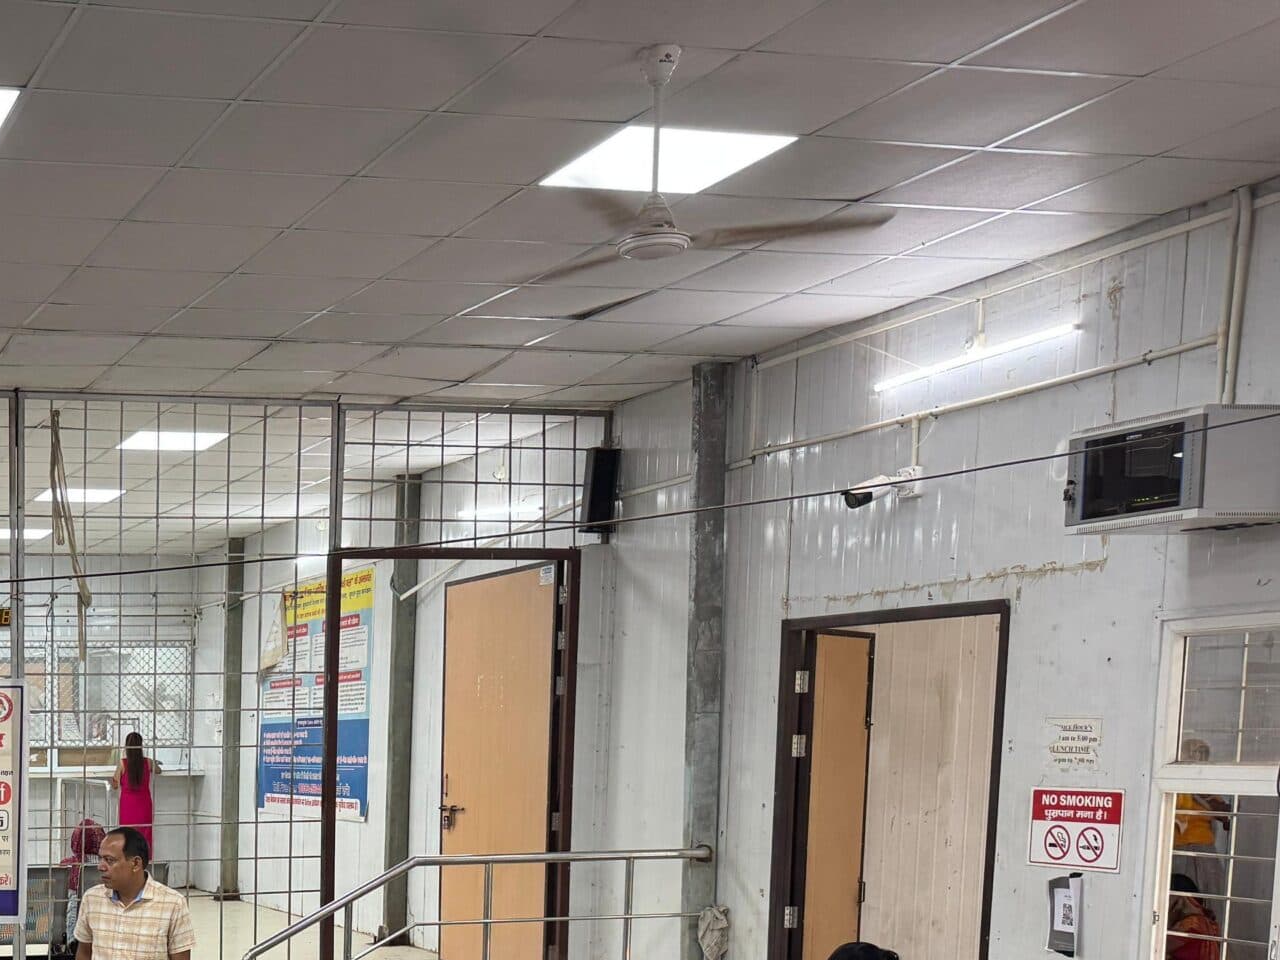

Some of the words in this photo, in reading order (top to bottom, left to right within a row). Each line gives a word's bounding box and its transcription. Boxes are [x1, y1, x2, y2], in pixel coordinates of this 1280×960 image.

[1041, 794, 1058, 806] NO
[1059, 795, 1113, 808] SMOKING
[1075, 810, 1095, 819] मना
